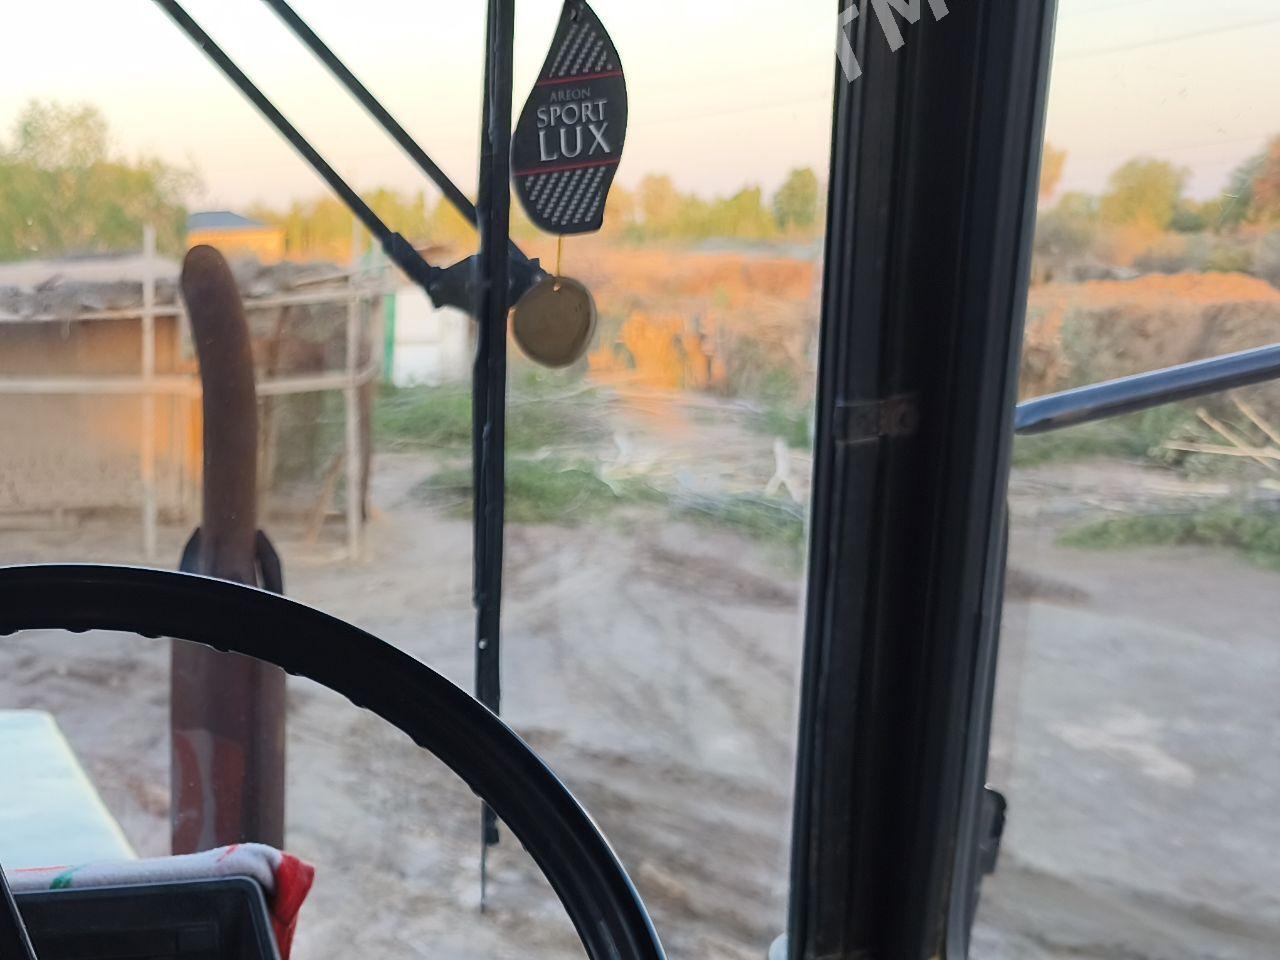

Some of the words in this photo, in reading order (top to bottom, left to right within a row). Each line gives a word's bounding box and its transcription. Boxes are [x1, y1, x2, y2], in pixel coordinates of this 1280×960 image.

[549, 87, 591, 101] AREON
[536, 100, 607, 128] SPORT
[538, 122, 610, 162] LUX
